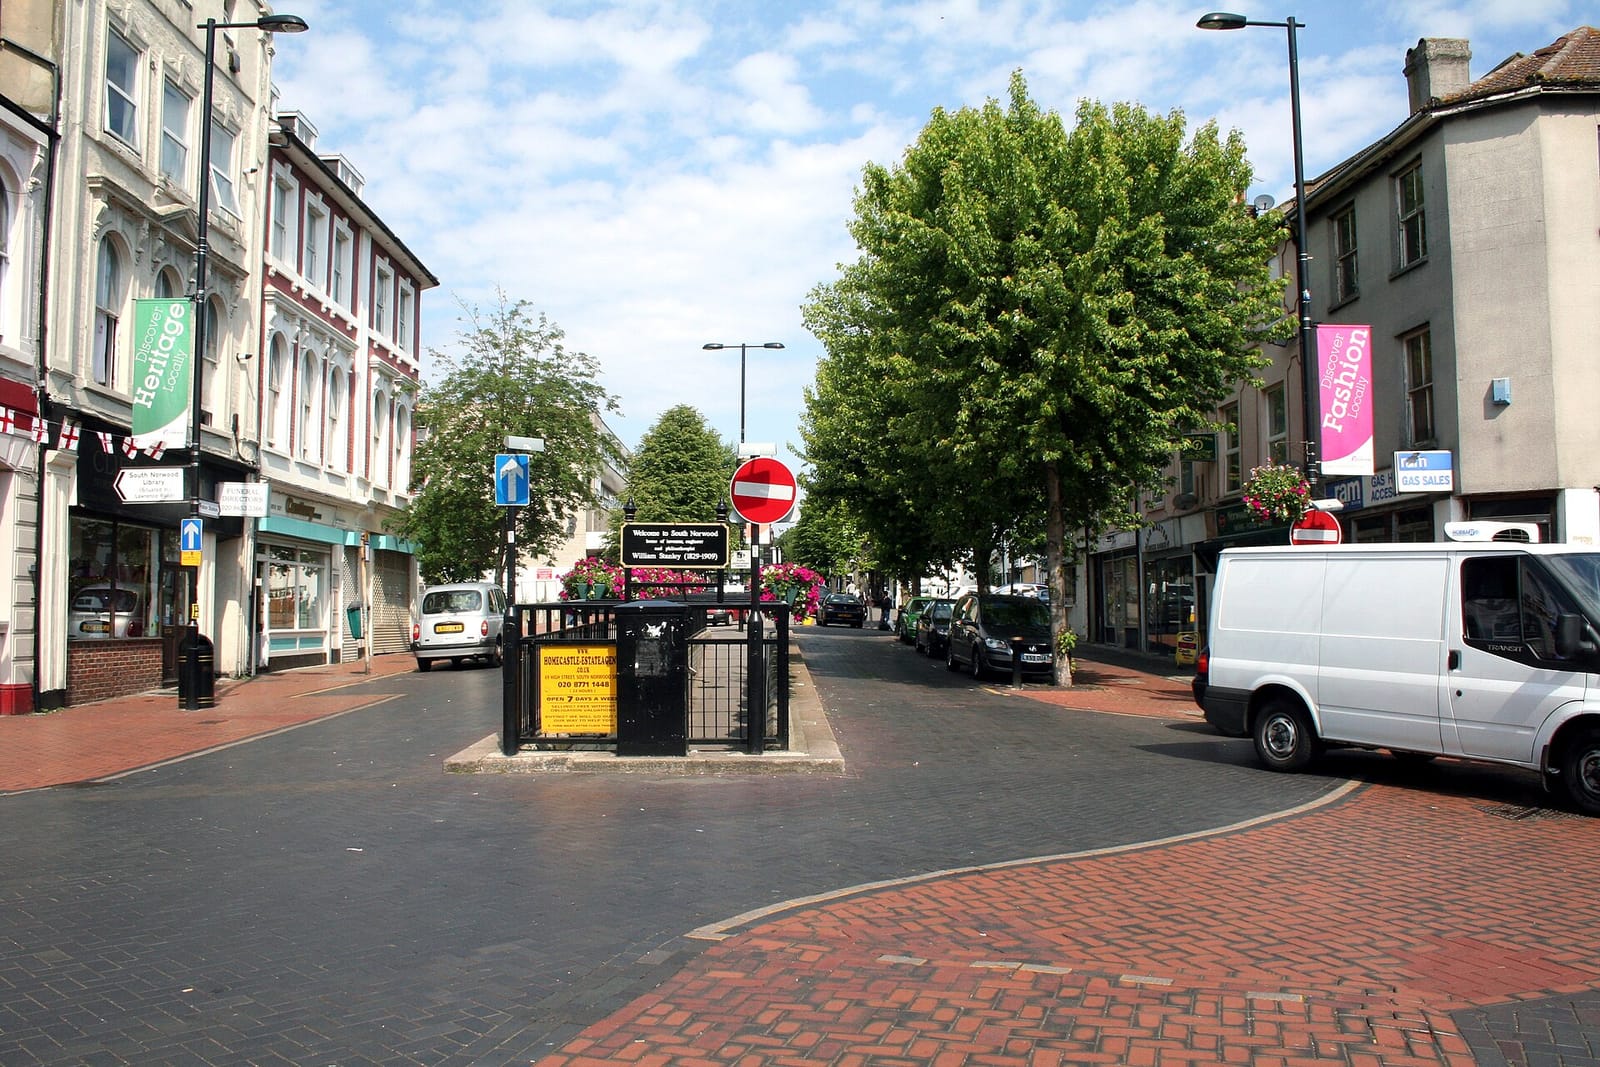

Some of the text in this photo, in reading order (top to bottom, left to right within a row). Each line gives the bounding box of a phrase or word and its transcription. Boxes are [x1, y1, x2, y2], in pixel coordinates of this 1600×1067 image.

[135, 306, 164, 364] Discover
[133, 303, 185, 409] Heritage
[1321, 332, 1345, 390] Discover
[162, 349, 188, 393] Locally
[1322, 328, 1369, 433] Fashion
[1347, 375, 1369, 420] Locally
[1333, 480, 1360, 503] ram
[1371, 474, 1385, 488] GAS
[1402, 475, 1450, 486] GAS SALES
[1371, 486, 1397, 501] ACCES
[632, 552, 719, 561] William Stanley (1829-1909)
[1488, 644, 1523, 653] TRANSIT
[567, 695, 574, 703] 7
